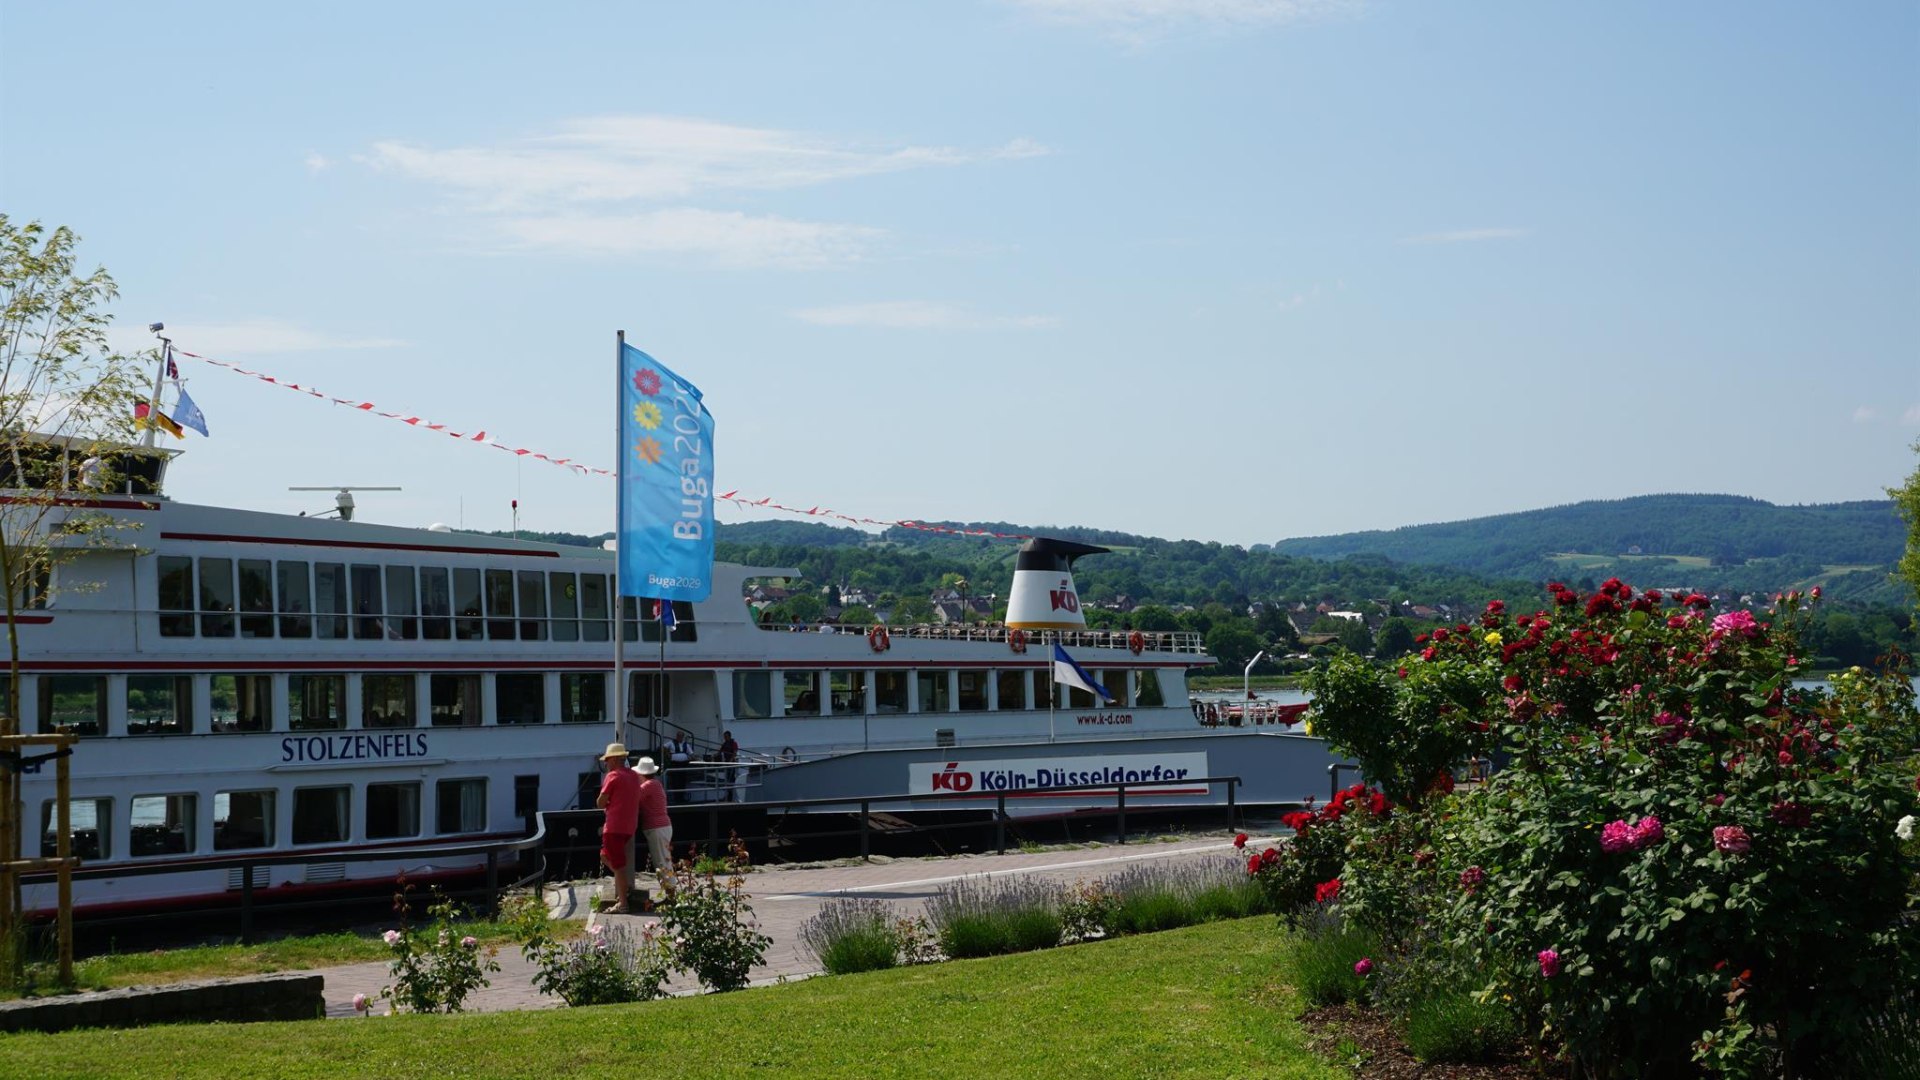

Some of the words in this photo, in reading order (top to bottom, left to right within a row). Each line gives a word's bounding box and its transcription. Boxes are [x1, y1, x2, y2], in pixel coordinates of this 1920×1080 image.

[648, 573, 701, 589] Buga2029
[1049, 580, 1079, 613] KD
[1076, 712, 1133, 725] www.k-d.com
[281, 733, 428, 762] STOLZENFELS
[932, 762, 973, 792] KD
[979, 764, 1188, 791] Köln-Düsseldorfer
